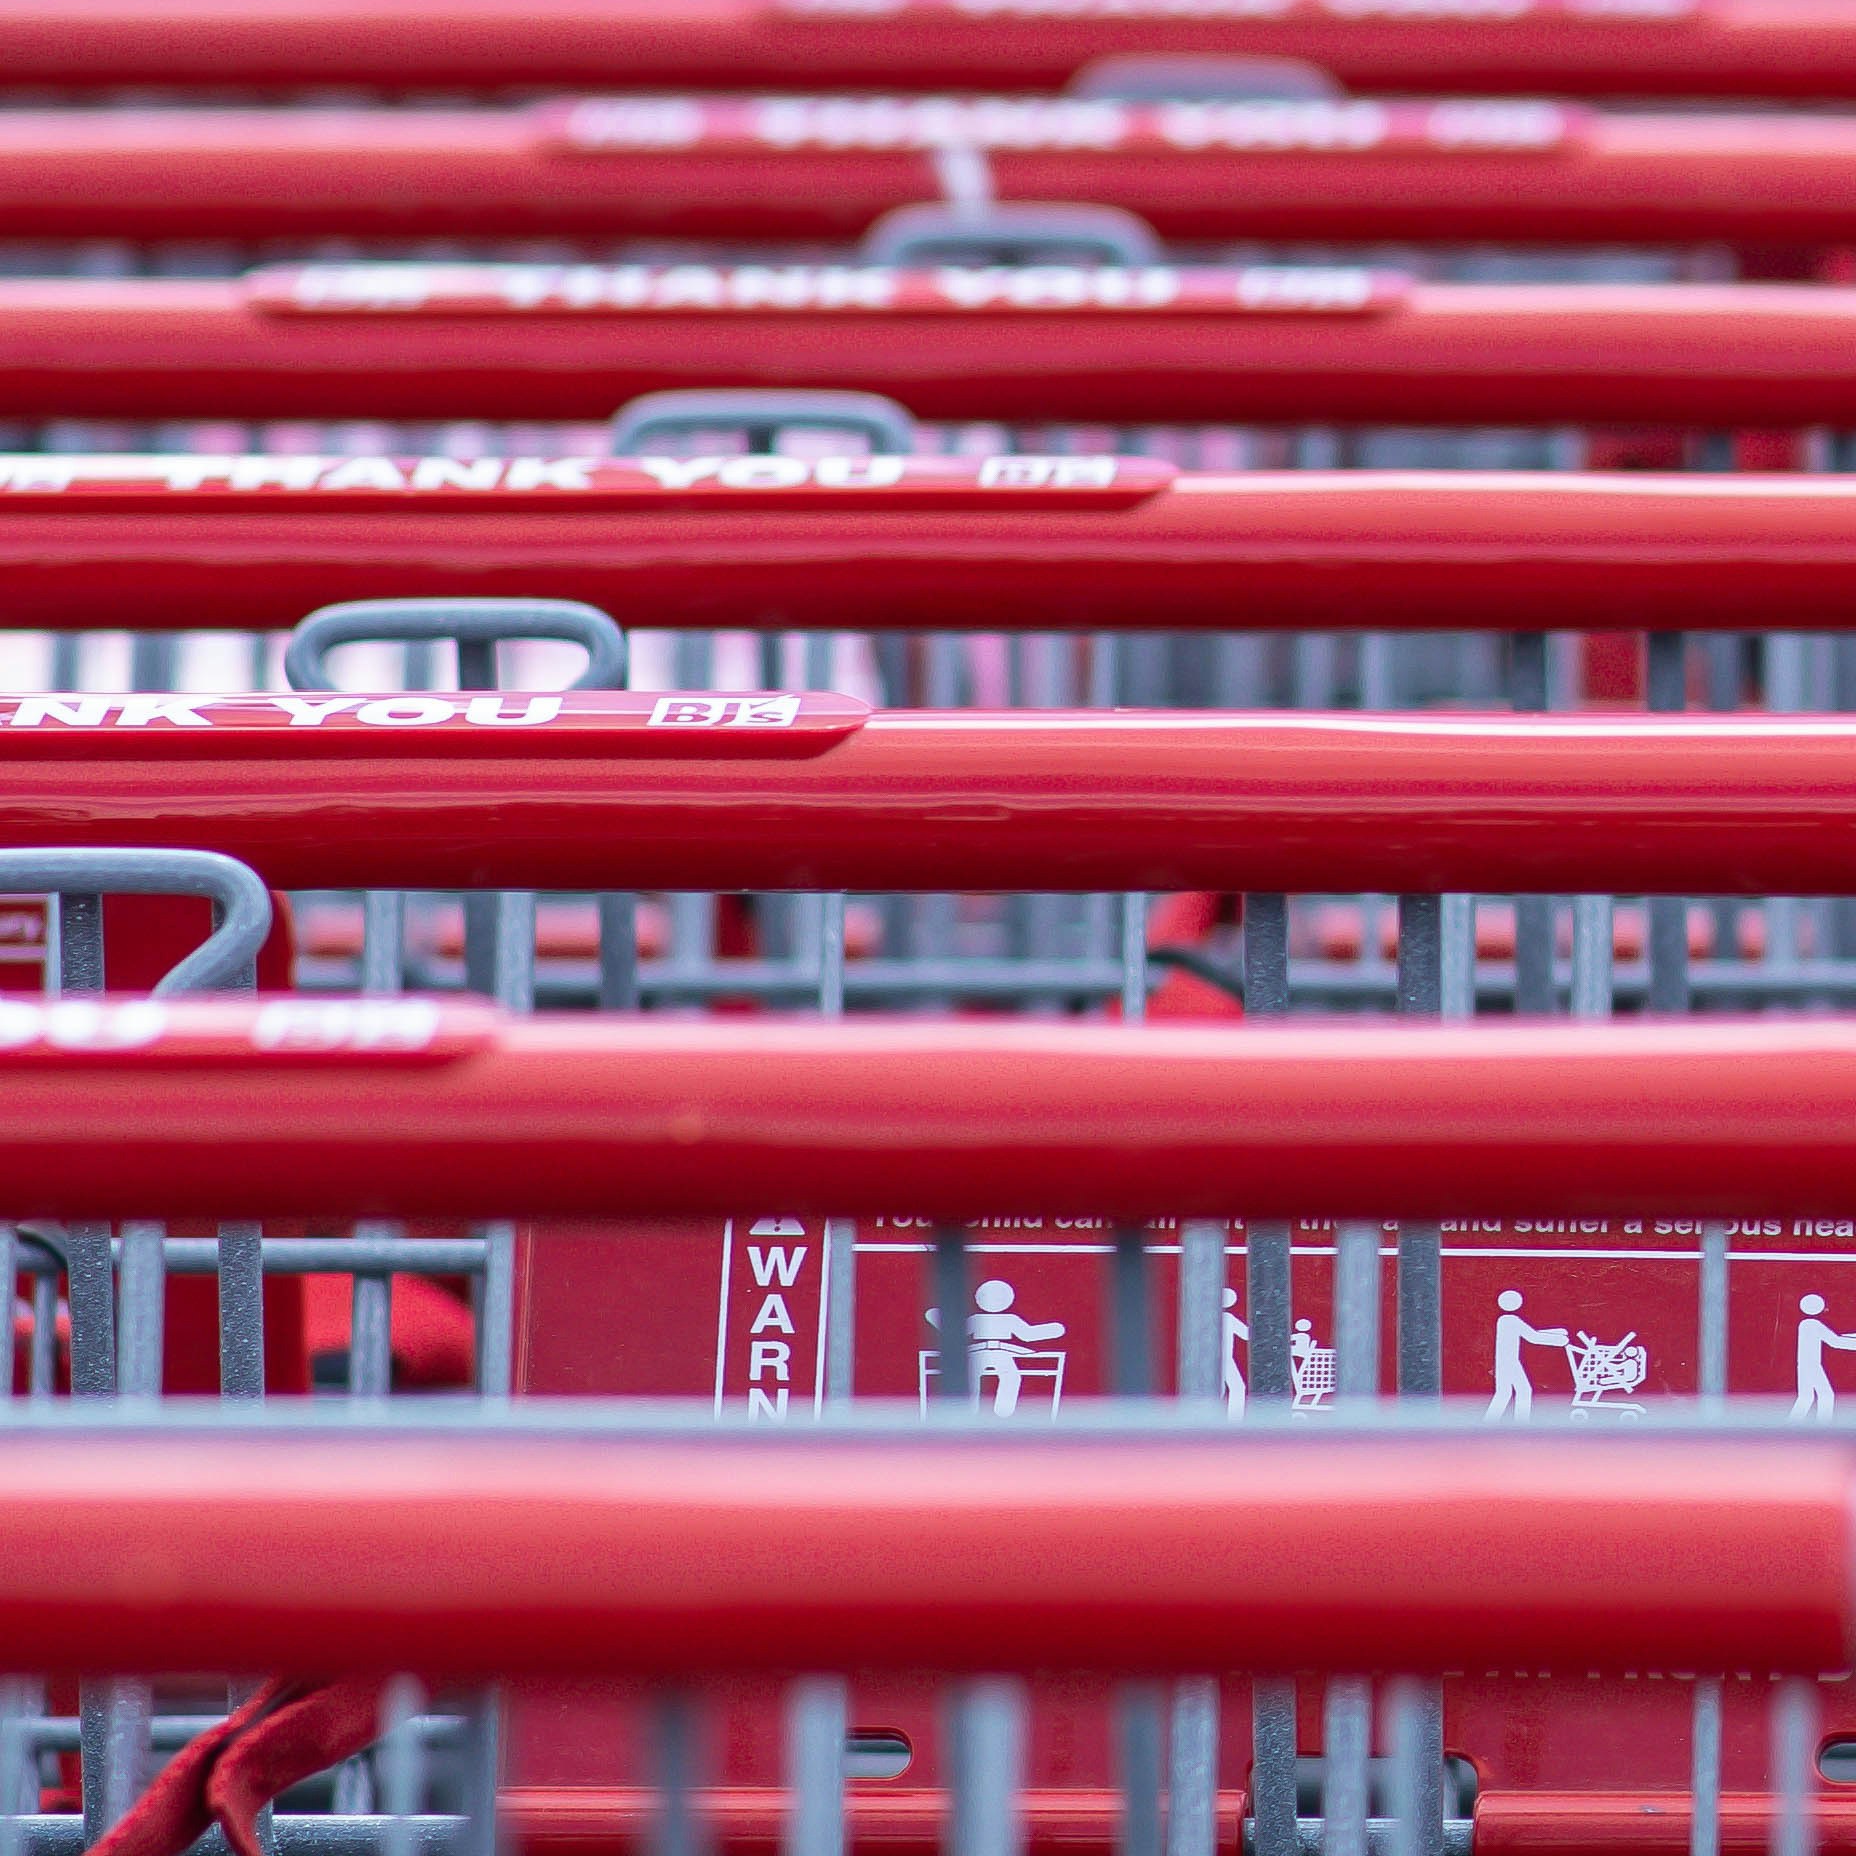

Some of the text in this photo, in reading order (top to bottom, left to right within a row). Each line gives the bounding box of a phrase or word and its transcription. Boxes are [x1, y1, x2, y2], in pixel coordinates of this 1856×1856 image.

[155, 456, 905, 491] THANK YOU
[0, 697, 216, 727] NK
[266, 697, 563, 726] YOU
